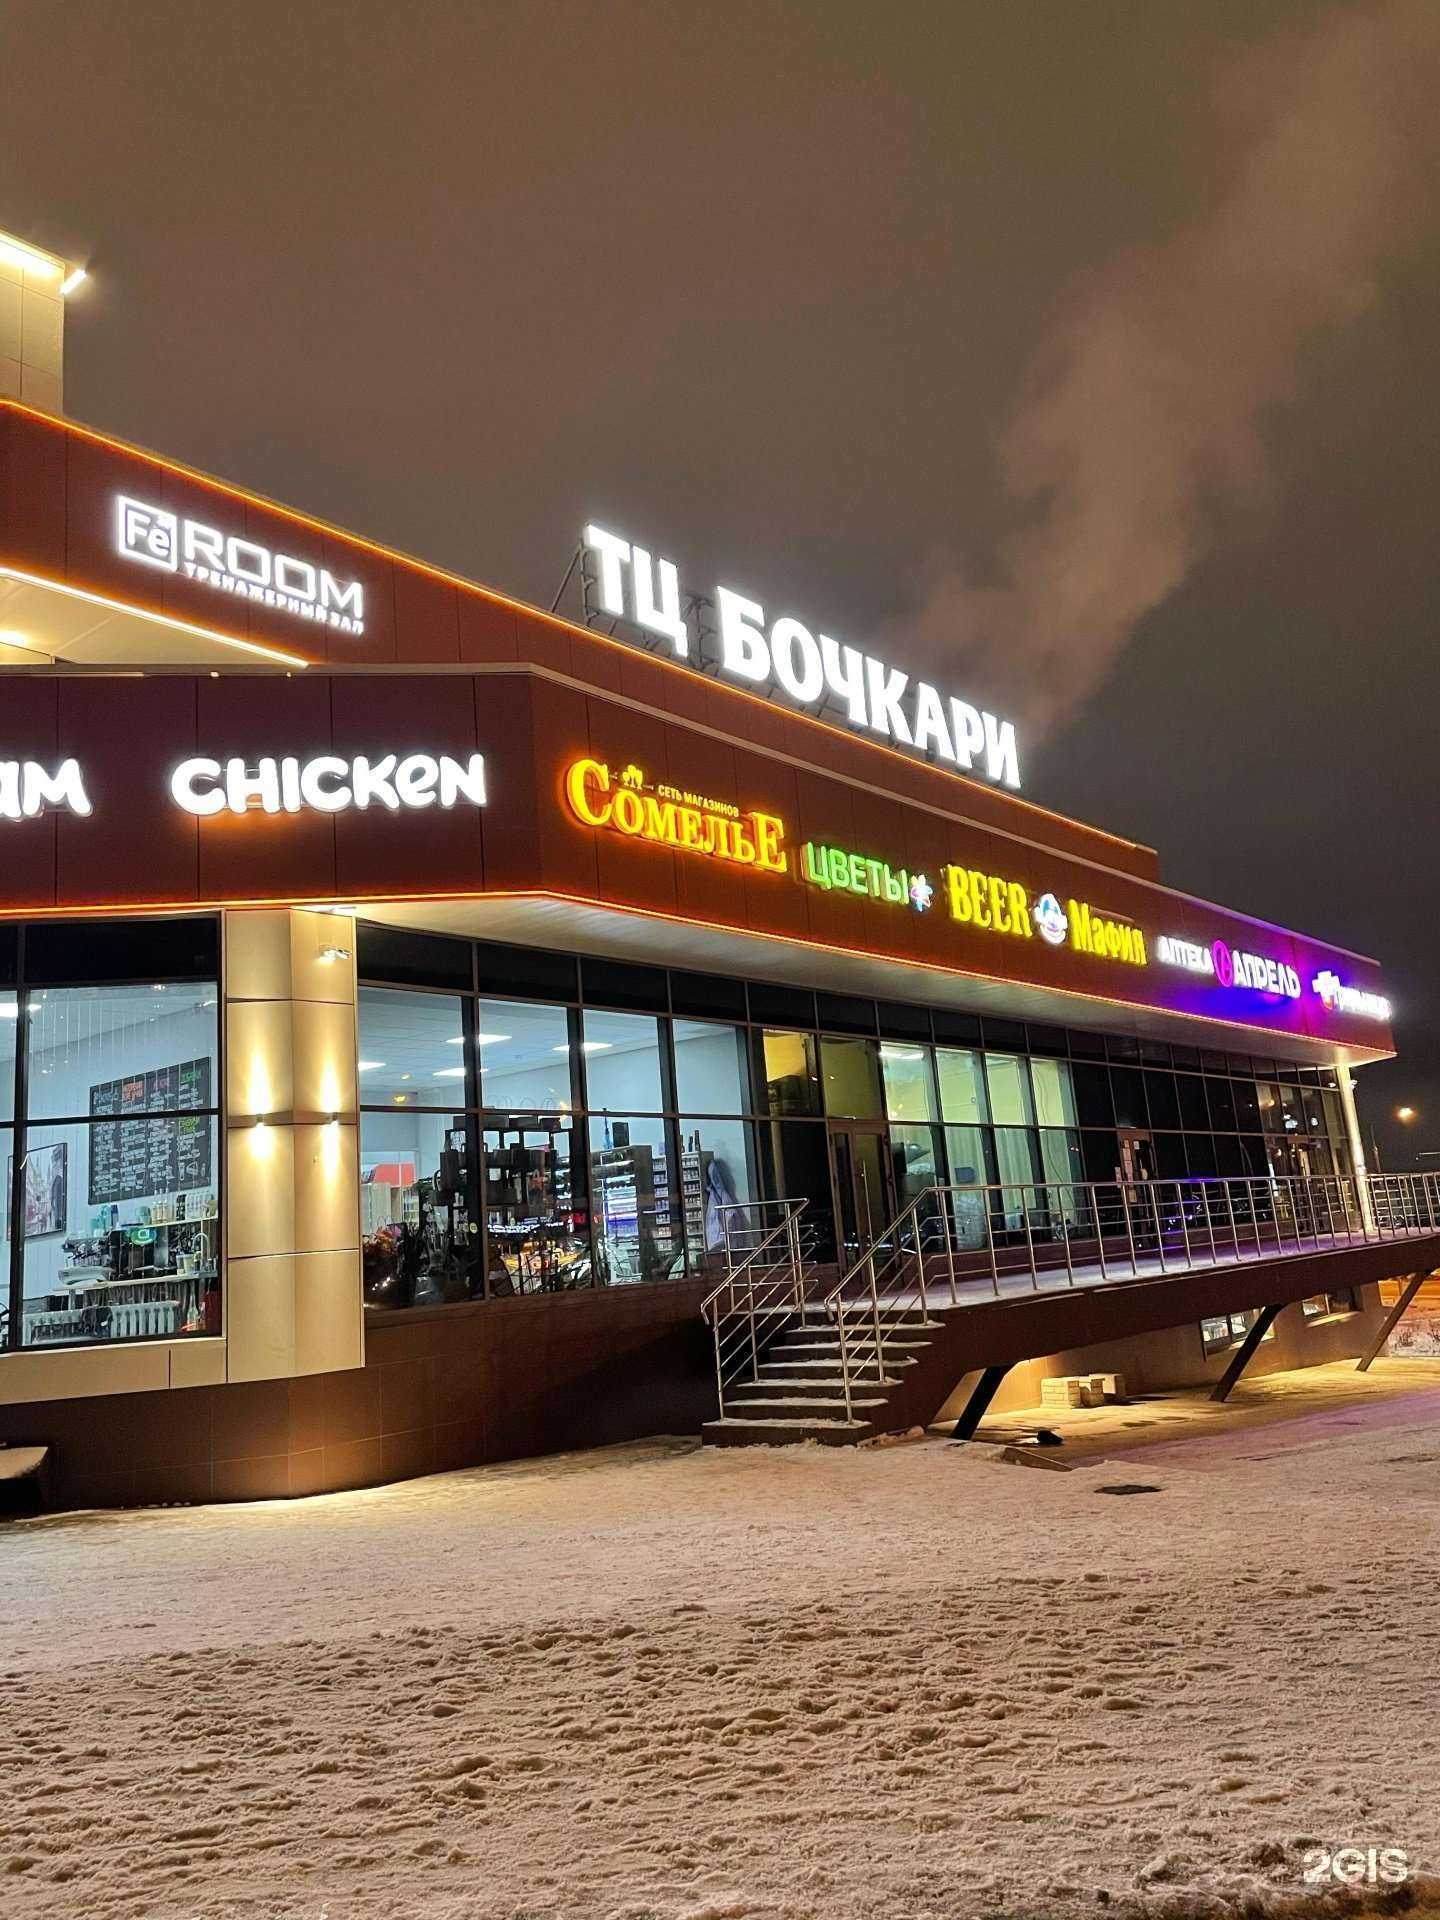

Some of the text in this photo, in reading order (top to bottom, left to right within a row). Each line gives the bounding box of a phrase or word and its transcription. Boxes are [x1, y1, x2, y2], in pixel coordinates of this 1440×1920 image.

[184, 519, 363, 618] ROOM
[184, 561, 364, 635] ТРЕНАЖЕРНЫЙ ЗАЛ
[586, 524, 1021, 789] ТЦ БОЧКАРИ
[658, 784, 739, 818] СЕТЬ МАГАЗИНОВ
[802, 841, 910, 905] ЦВЕТЫ
[945, 864, 1033, 938] BEER
[1157, 935, 1215, 975] АПТЕКА
